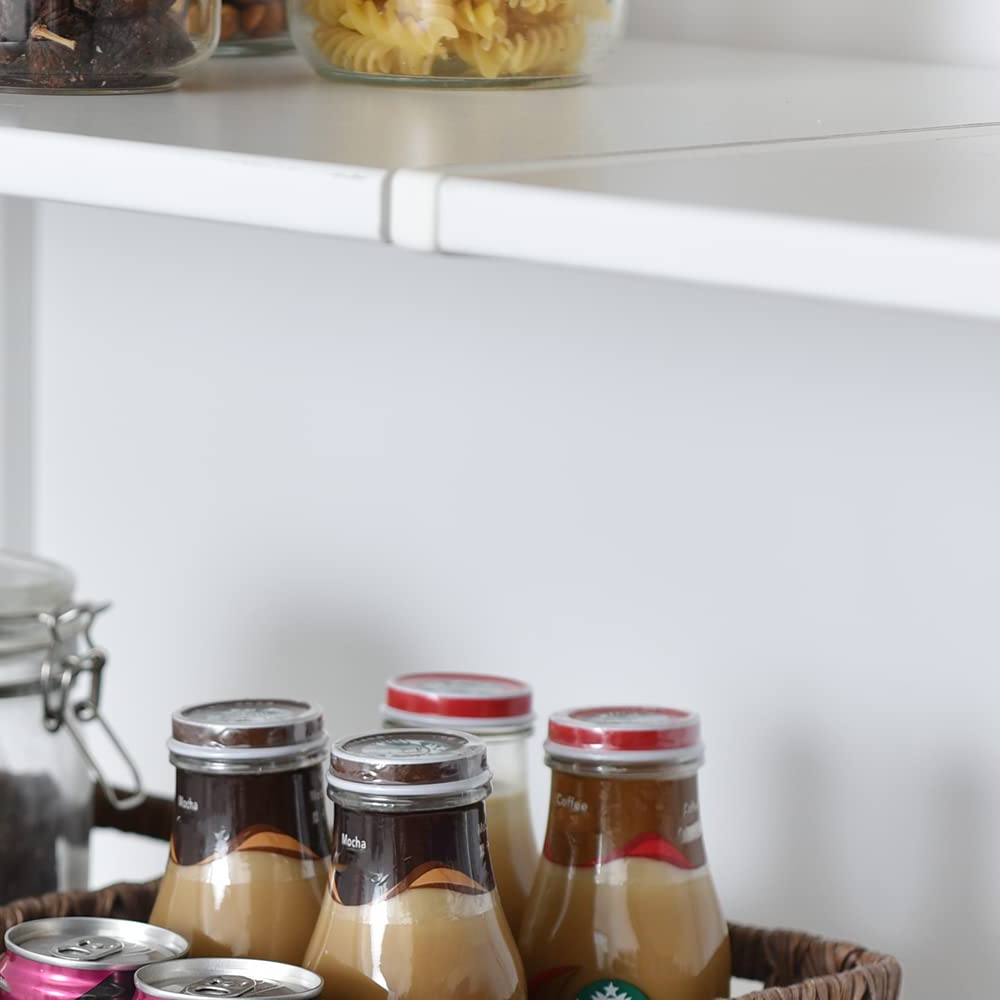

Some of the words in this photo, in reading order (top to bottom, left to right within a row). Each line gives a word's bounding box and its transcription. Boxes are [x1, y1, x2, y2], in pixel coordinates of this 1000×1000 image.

[178, 794, 199, 812] Mocha
[555, 793, 589, 813] Coffee
[341, 832, 367, 850] Mocha
